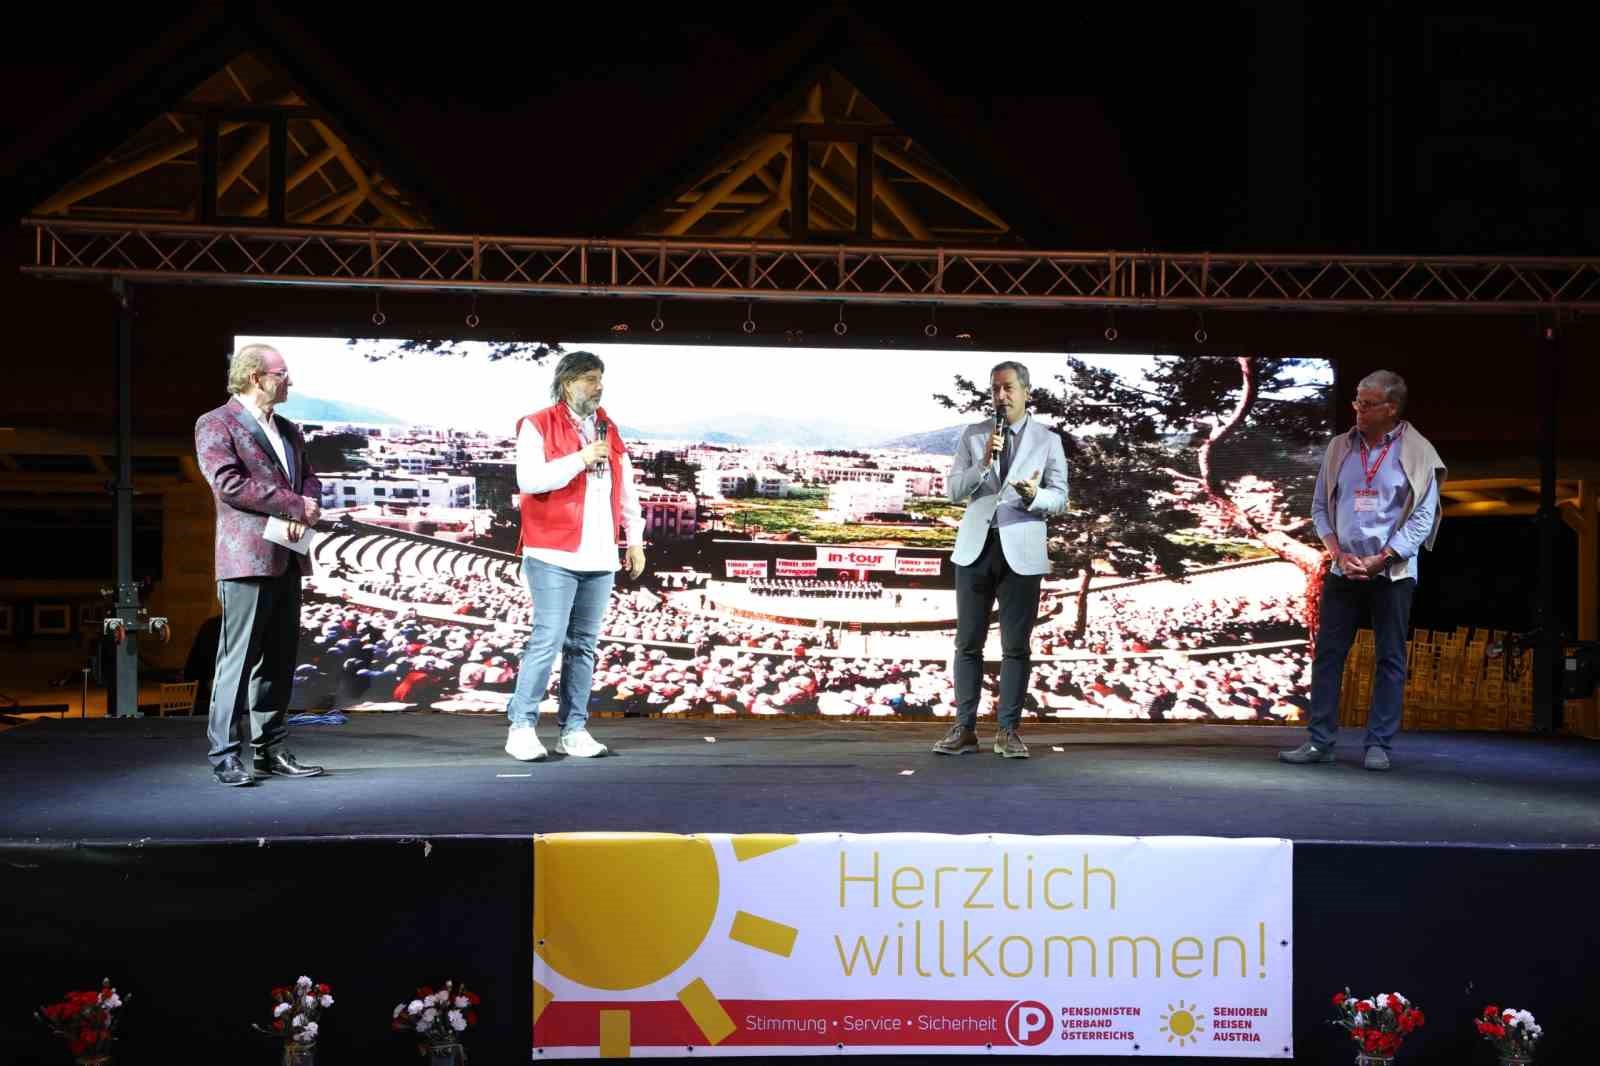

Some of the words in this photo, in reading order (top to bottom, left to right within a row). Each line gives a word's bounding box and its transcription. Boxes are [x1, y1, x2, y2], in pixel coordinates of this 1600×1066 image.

[839, 851, 1117, 911] Herzlich
[833, 920, 1267, 979] willkommen!
[1061, 1007, 1141, 1016] PENSIONISTEN
[1213, 1007, 1268, 1017] SENIOREN
[746, 1015, 826, 1034] Stimmung
[844, 1016, 901, 1031] Service
[918, 1015, 997, 1031] Sicherheit
[1061, 1019, 1112, 1028] VERBAND
[1213, 1020, 1252, 1029] REISEN
[1061, 1030, 1135, 1040] ÖSTERREICHS
[1213, 1032, 1261, 1042] AUSTRIA
